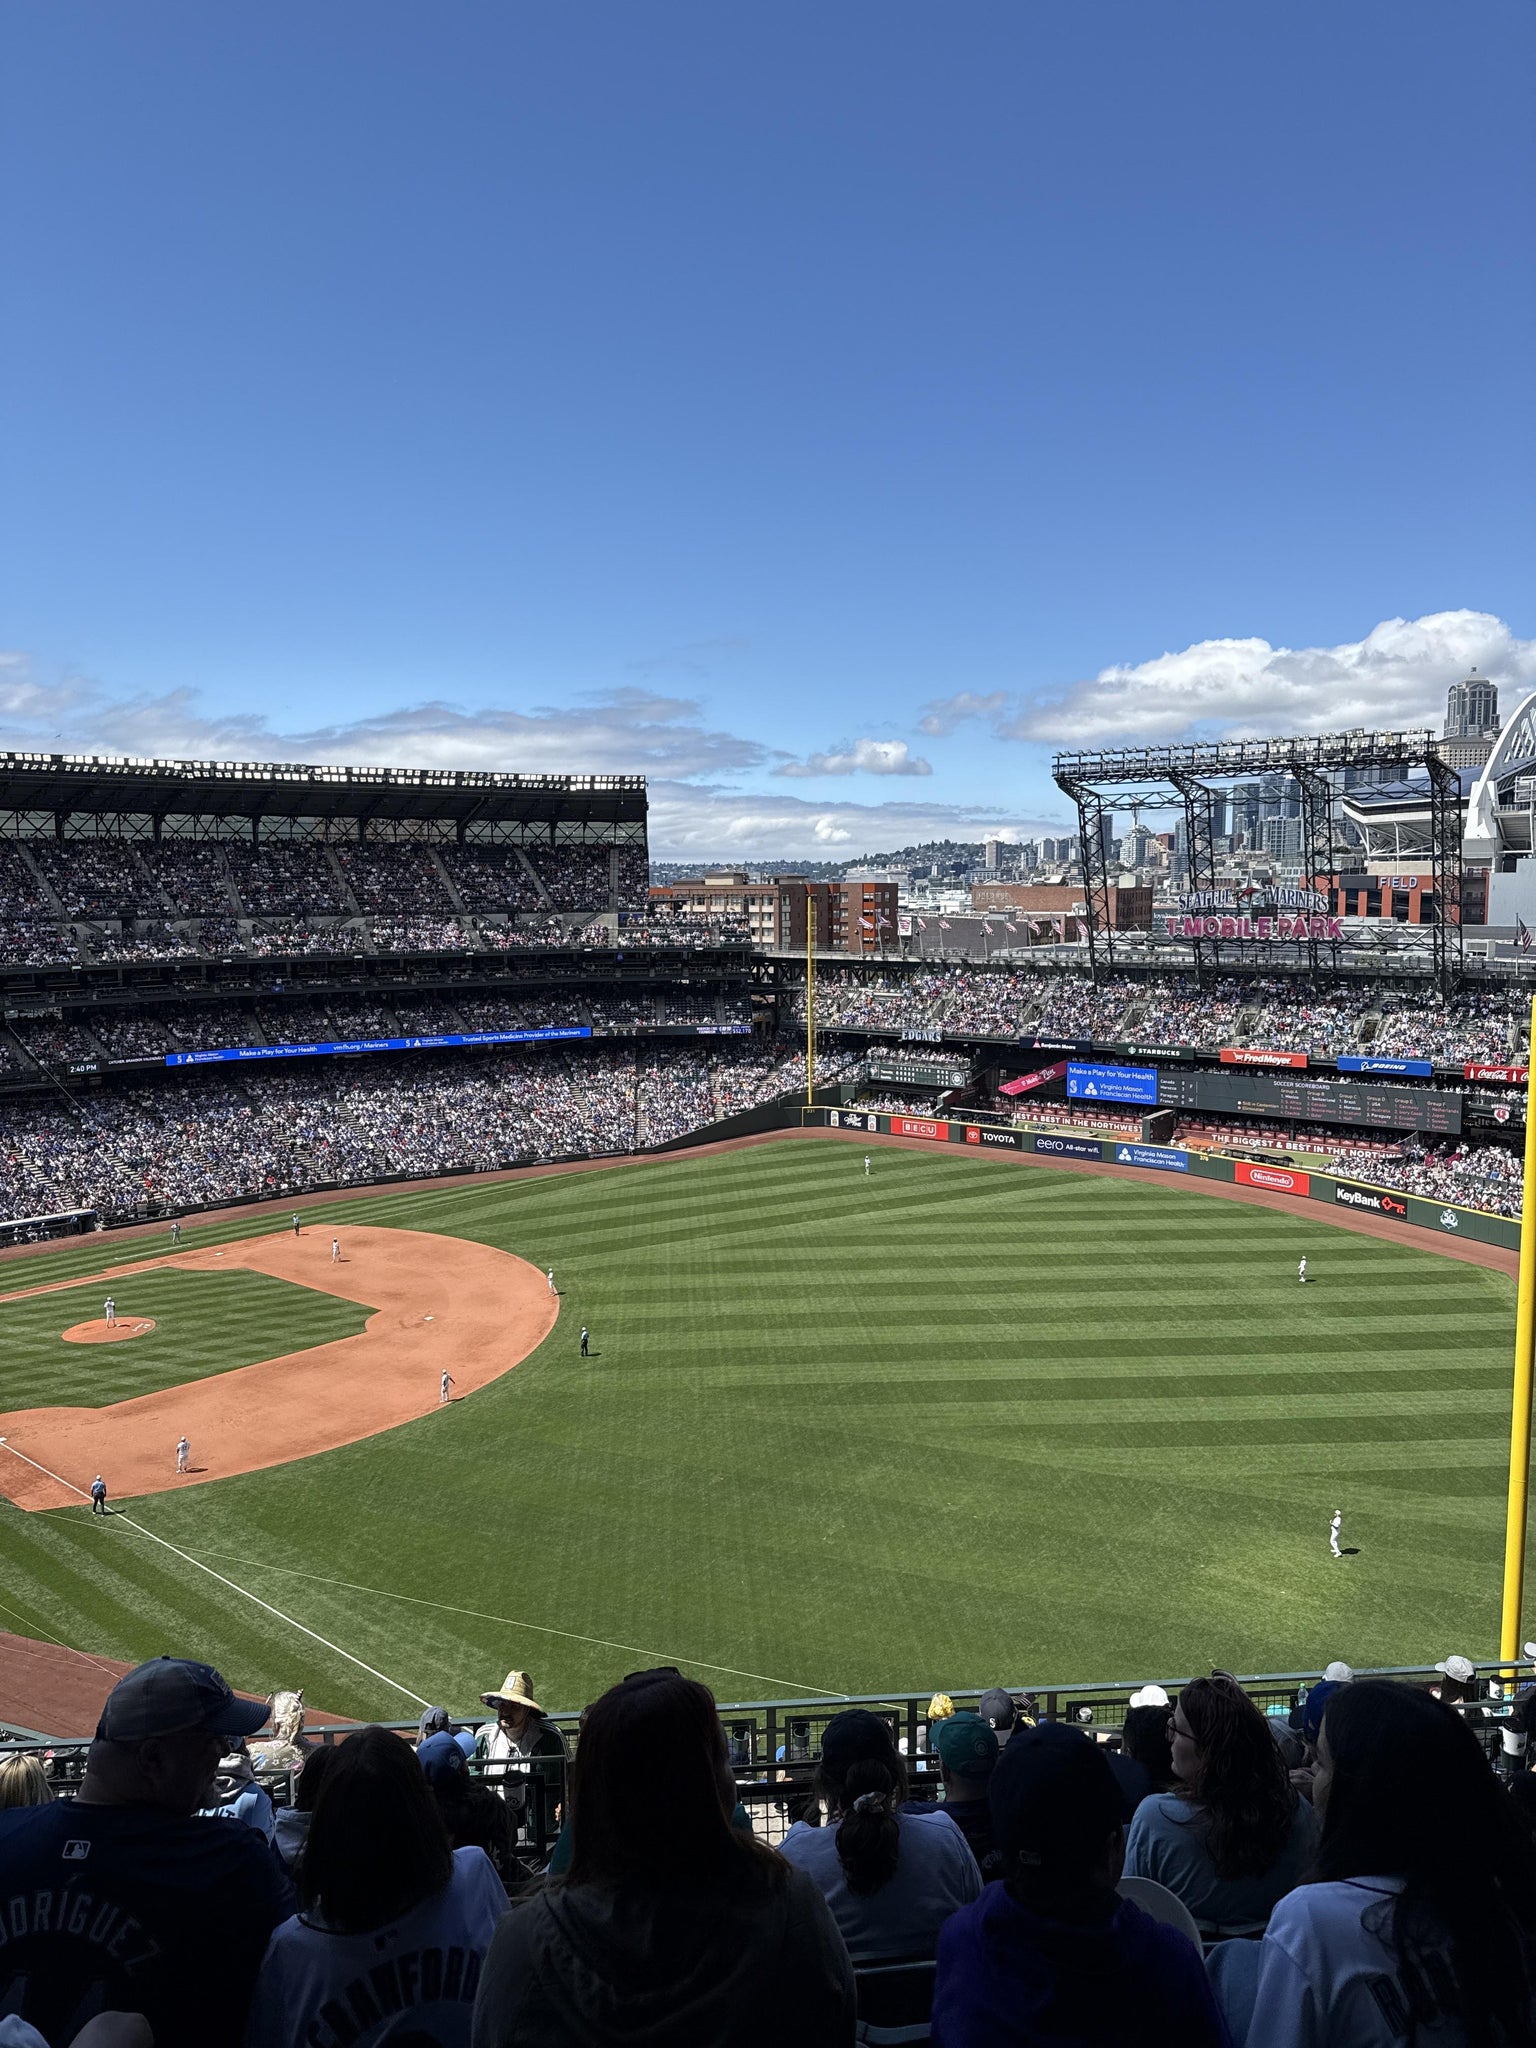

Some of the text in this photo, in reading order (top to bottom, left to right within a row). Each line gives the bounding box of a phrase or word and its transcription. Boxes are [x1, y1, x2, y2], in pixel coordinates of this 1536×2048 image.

[1380, 876, 1418, 888] FIELD
[1178, 885, 1329, 912] SEATTLE MARINERS
[1165, 916, 1345, 939] T-MOBILE PARK
[261, 1048, 274, 1056] Play
[297, 1045, 318, 1053] Health
[363, 1041, 389, 1049] Mariners
[1138, 1047, 1180, 1057] STARBUCKS
[70, 1064, 97, 1073] 2:40 PM
[1372, 1062, 1407, 1071] BOEING
[1069, 1067, 1087, 1075] Make
[1092, 1068, 1106, 1077] Play
[1116, 1071, 1132, 1079] Your
[1131, 1072, 1154, 1080] Health
[1099, 1083, 1143, 1093] Virginia Mason
[1295, 1082, 1330, 1090] SCOREBOARD
[1099, 1089, 1153, 1100] Franciscan Health
[904, 1122, 934, 1135] BECU
[1040, 1114, 1060, 1123] BEST
[1072, 1118, 1089, 1127] THE
[1090, 1121, 1142, 1132] NORTHWEST
[982, 1132, 1015, 1144] TOYOTA
[1036, 1138, 1064, 1150] eero
[1065, 1144, 1086, 1152] All-star
[1212, 1134, 1230, 1142] THE
[1232, 1136, 1273, 1148] BIGGEST
[1276, 1141, 1282, 1149] &
[1285, 1142, 1311, 1152] BEST
[1313, 1145, 1324, 1153] IN
[1326, 1147, 1347, 1156] THE
[1133, 1149, 1176, 1160] Virginia Mason
[1133, 1155, 1185, 1168] Franciscan Health
[424, 1170, 441, 1178] Clips
[473, 1163, 503, 1173] STIHL
[347, 1179, 375, 1187] LEXUS
[1253, 1171, 1290, 1186] Nintendo
[1336, 1187, 1381, 1209] KeyBank
[989, 1717, 996, 1729] S
